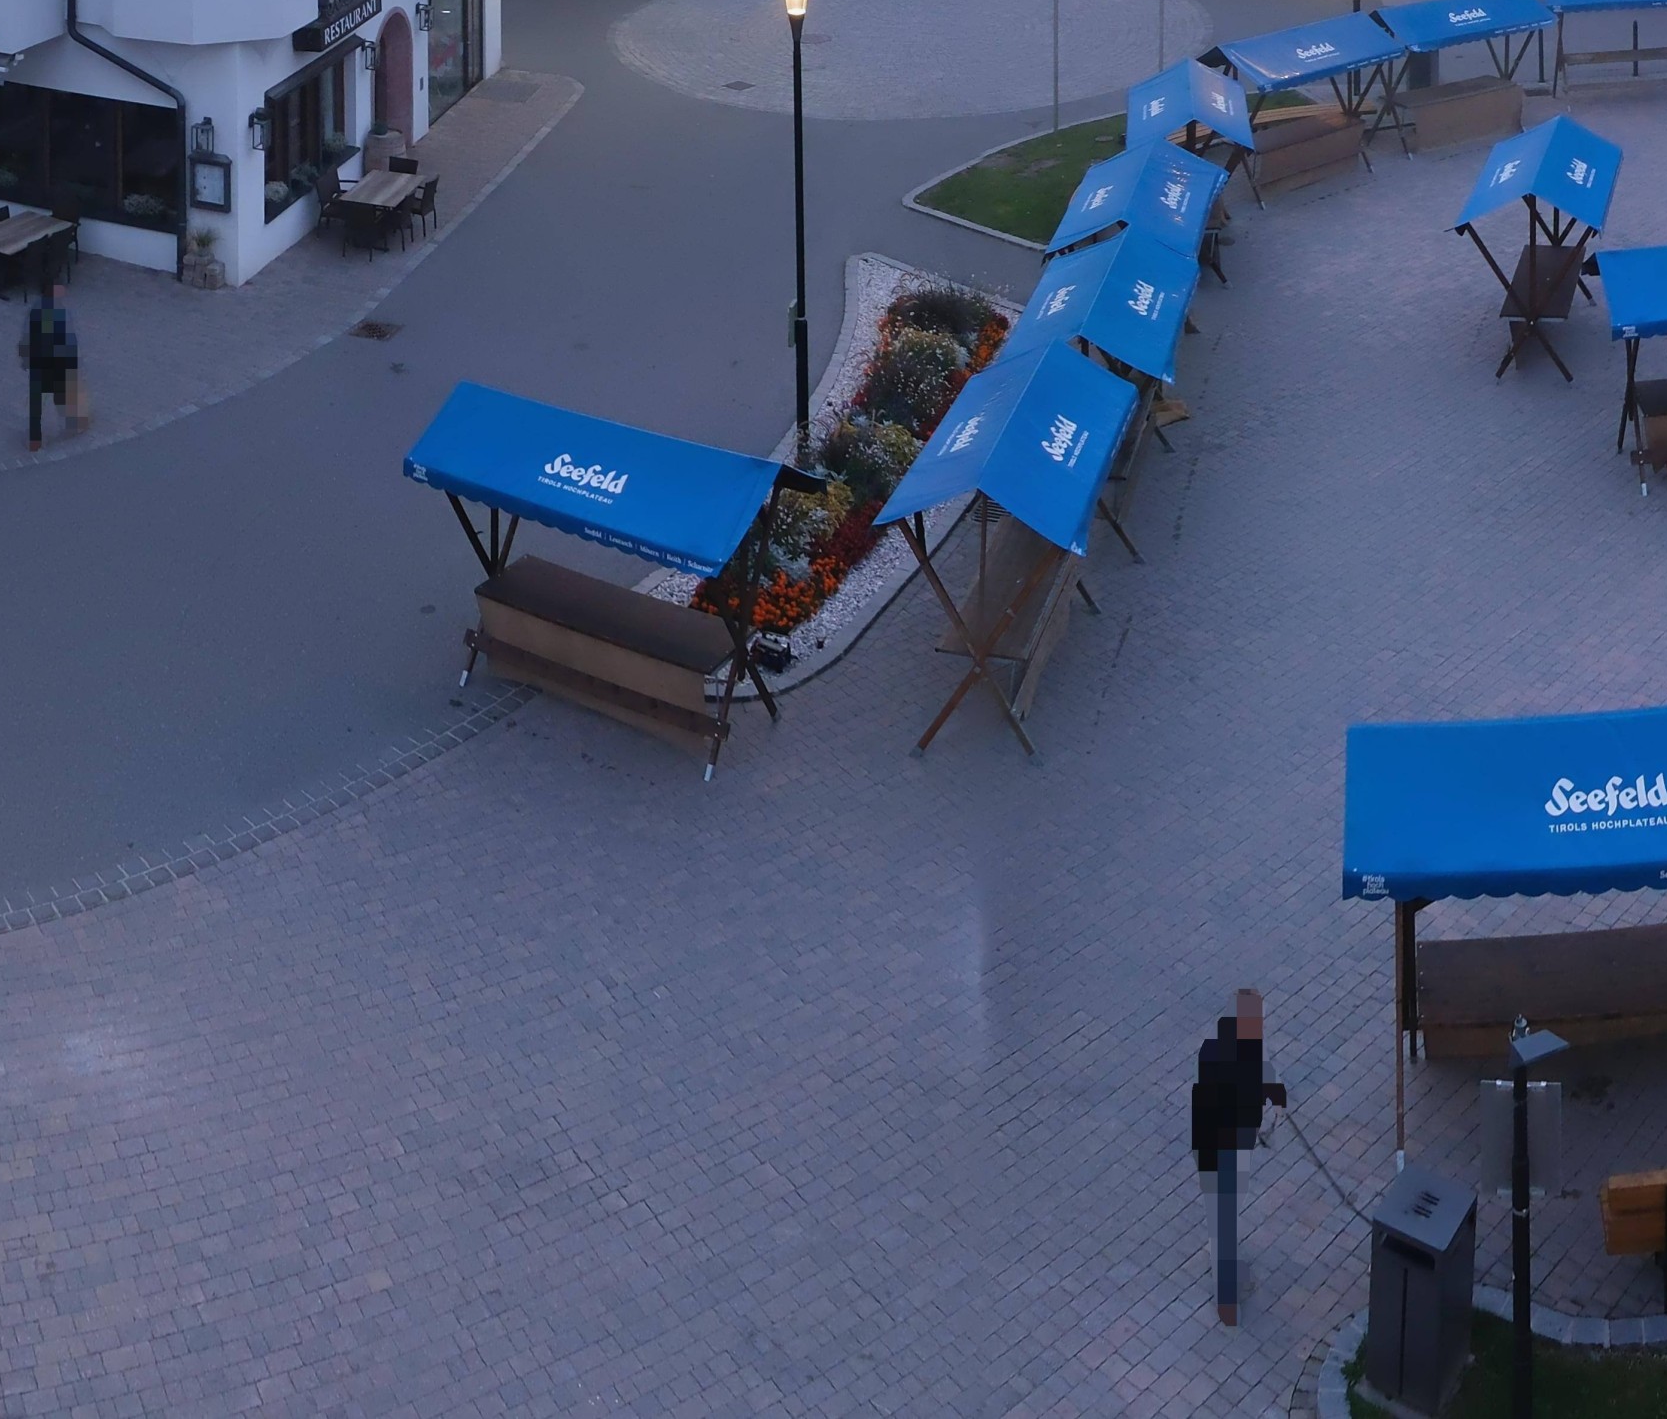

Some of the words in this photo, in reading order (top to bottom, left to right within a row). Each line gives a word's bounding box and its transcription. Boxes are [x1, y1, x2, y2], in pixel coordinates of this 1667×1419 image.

[1449, 7, 1487, 24] Seefeld
[1295, 42, 1336, 59] Seefeld
[1041, 414, 1077, 462] Seefeld
[544, 453, 629, 495] Seefeld
[537, 475, 562, 489] TIROLS
[562, 483, 613, 505] HOCHPLATEAU
[1548, 822, 1588, 834] TIROLS
